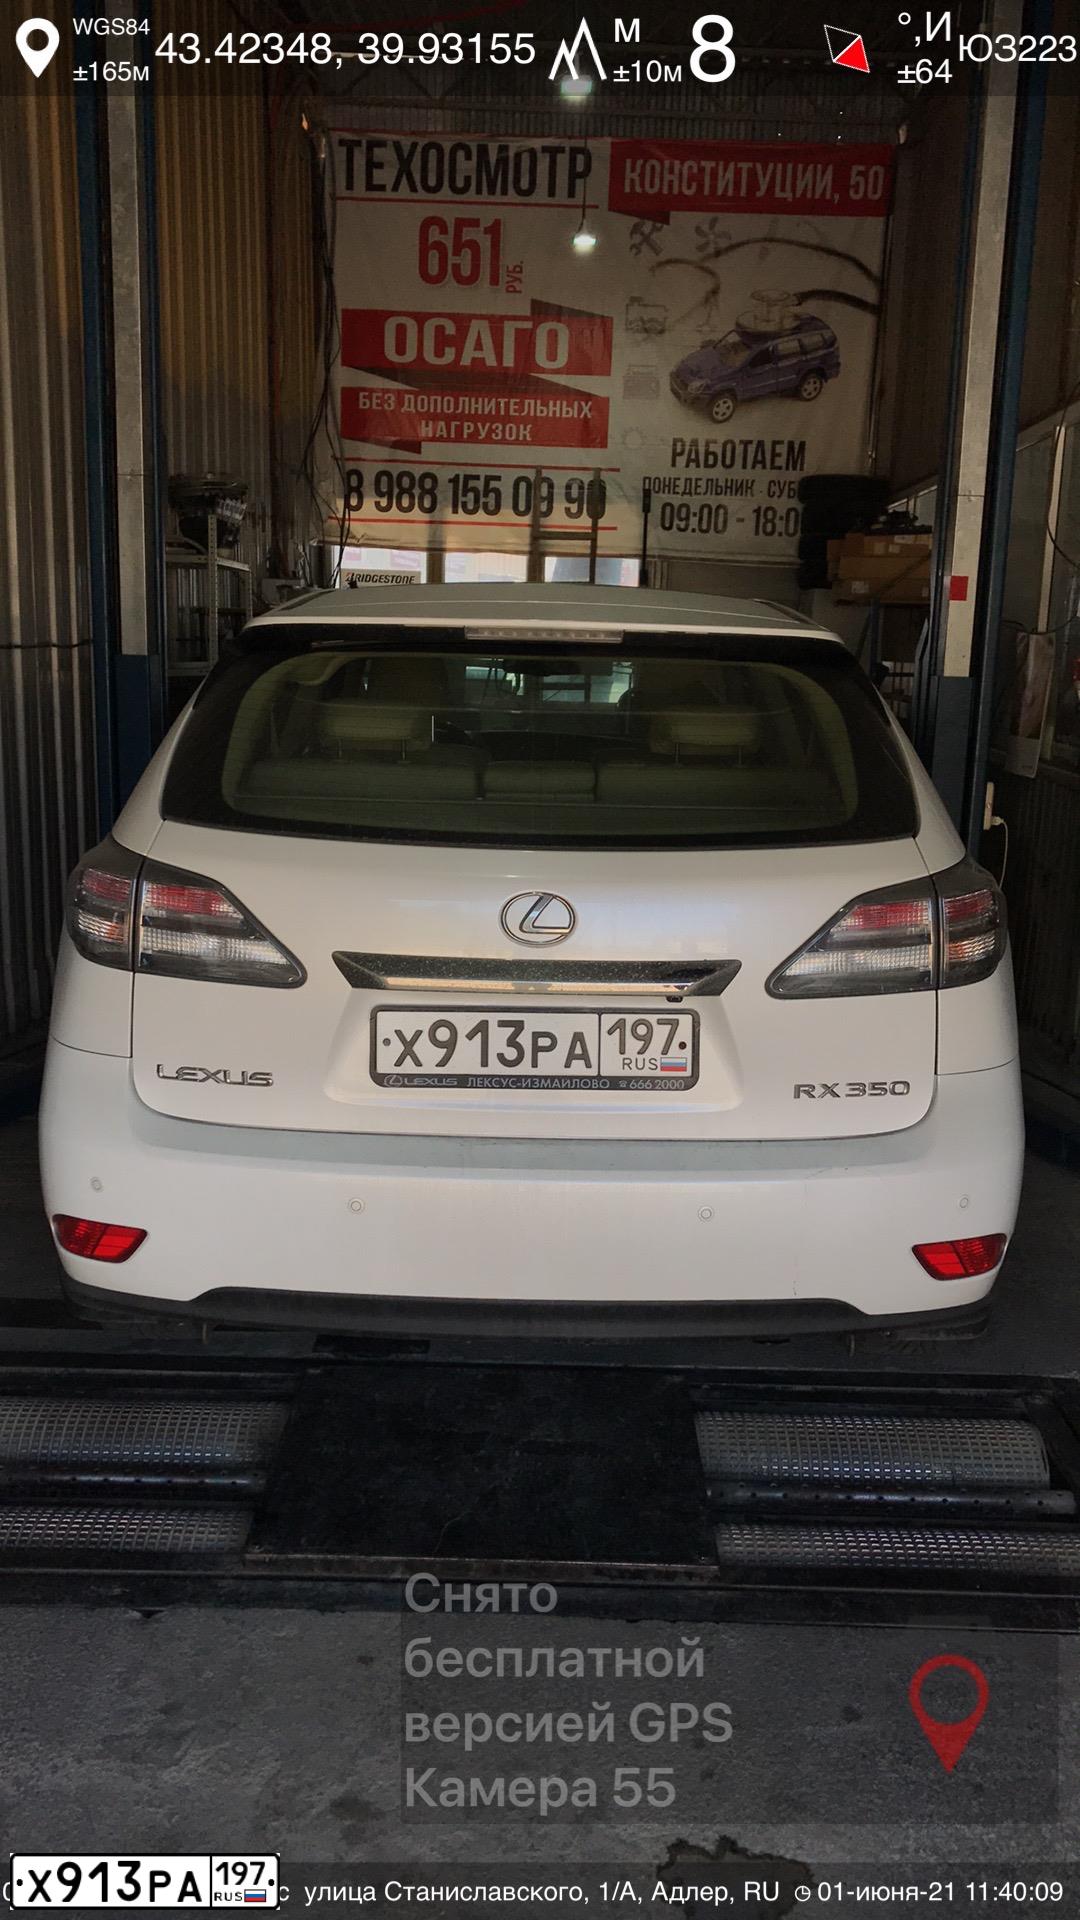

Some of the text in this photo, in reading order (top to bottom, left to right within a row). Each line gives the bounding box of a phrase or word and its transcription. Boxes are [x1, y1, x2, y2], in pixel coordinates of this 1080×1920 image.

[338, 138, 592, 199] ТЕХОСМОТР
[624, 158, 885, 204] КОНСТИТУЦИИ, 50
[417, 215, 502, 288] 651
[505, 260, 524, 294] РУБ.
[383, 316, 570, 370] ОСАГО
[358, 392, 593, 419] БЕЗ ДОПОЛНИТЕЛЬНЫХ
[420, 420, 533, 442] НАГРУЗОК
[671, 437, 806, 471] РАБОТАЕМ
[346, 468, 364, 512] 8
[373, 470, 439, 514] 988
[449, 473, 502, 516] 155
[512, 475, 554, 518] 09
[643, 476, 801, 500] ПОНЕДЕЛЬНИК СУБ
[660, 502, 729, 535] 09:00
[752, 506, 800, 538] 18:0
[607, 1017, 680, 1056] 197
[156, 1063, 274, 1088] LEXUS
[622, 1057, 658, 1071] RUS
[404, 1078, 458, 1087] LEXUS
[629, 1080, 685, 1090] 666 2000
[793, 1080, 911, 1099] RX 350
